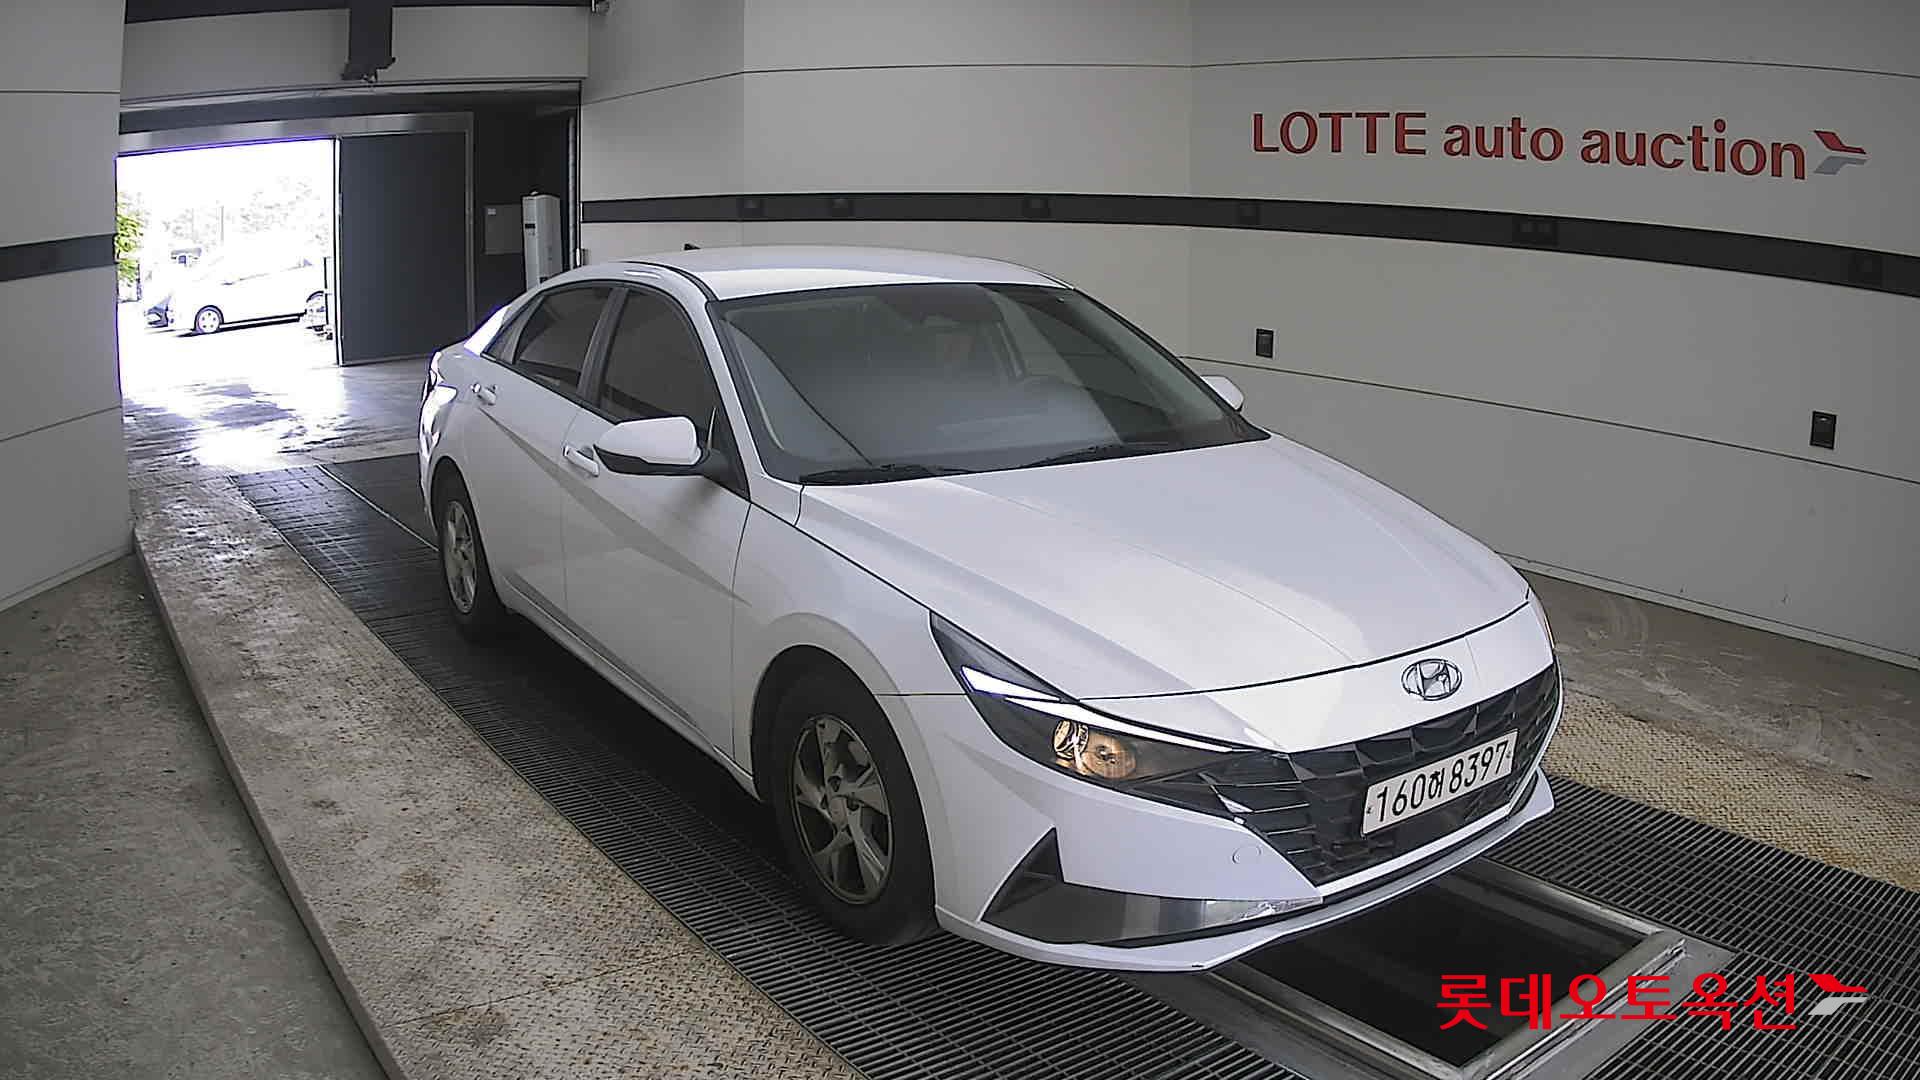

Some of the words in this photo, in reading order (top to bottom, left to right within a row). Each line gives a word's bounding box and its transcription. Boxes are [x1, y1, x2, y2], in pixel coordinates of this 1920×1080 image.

[1253, 111, 1426, 155] LOTTE
[1443, 117, 1564, 161] auto
[1580, 118, 1806, 180] auction
[1377, 768, 1445, 822] 160허
[1449, 740, 1509, 794] 8397
